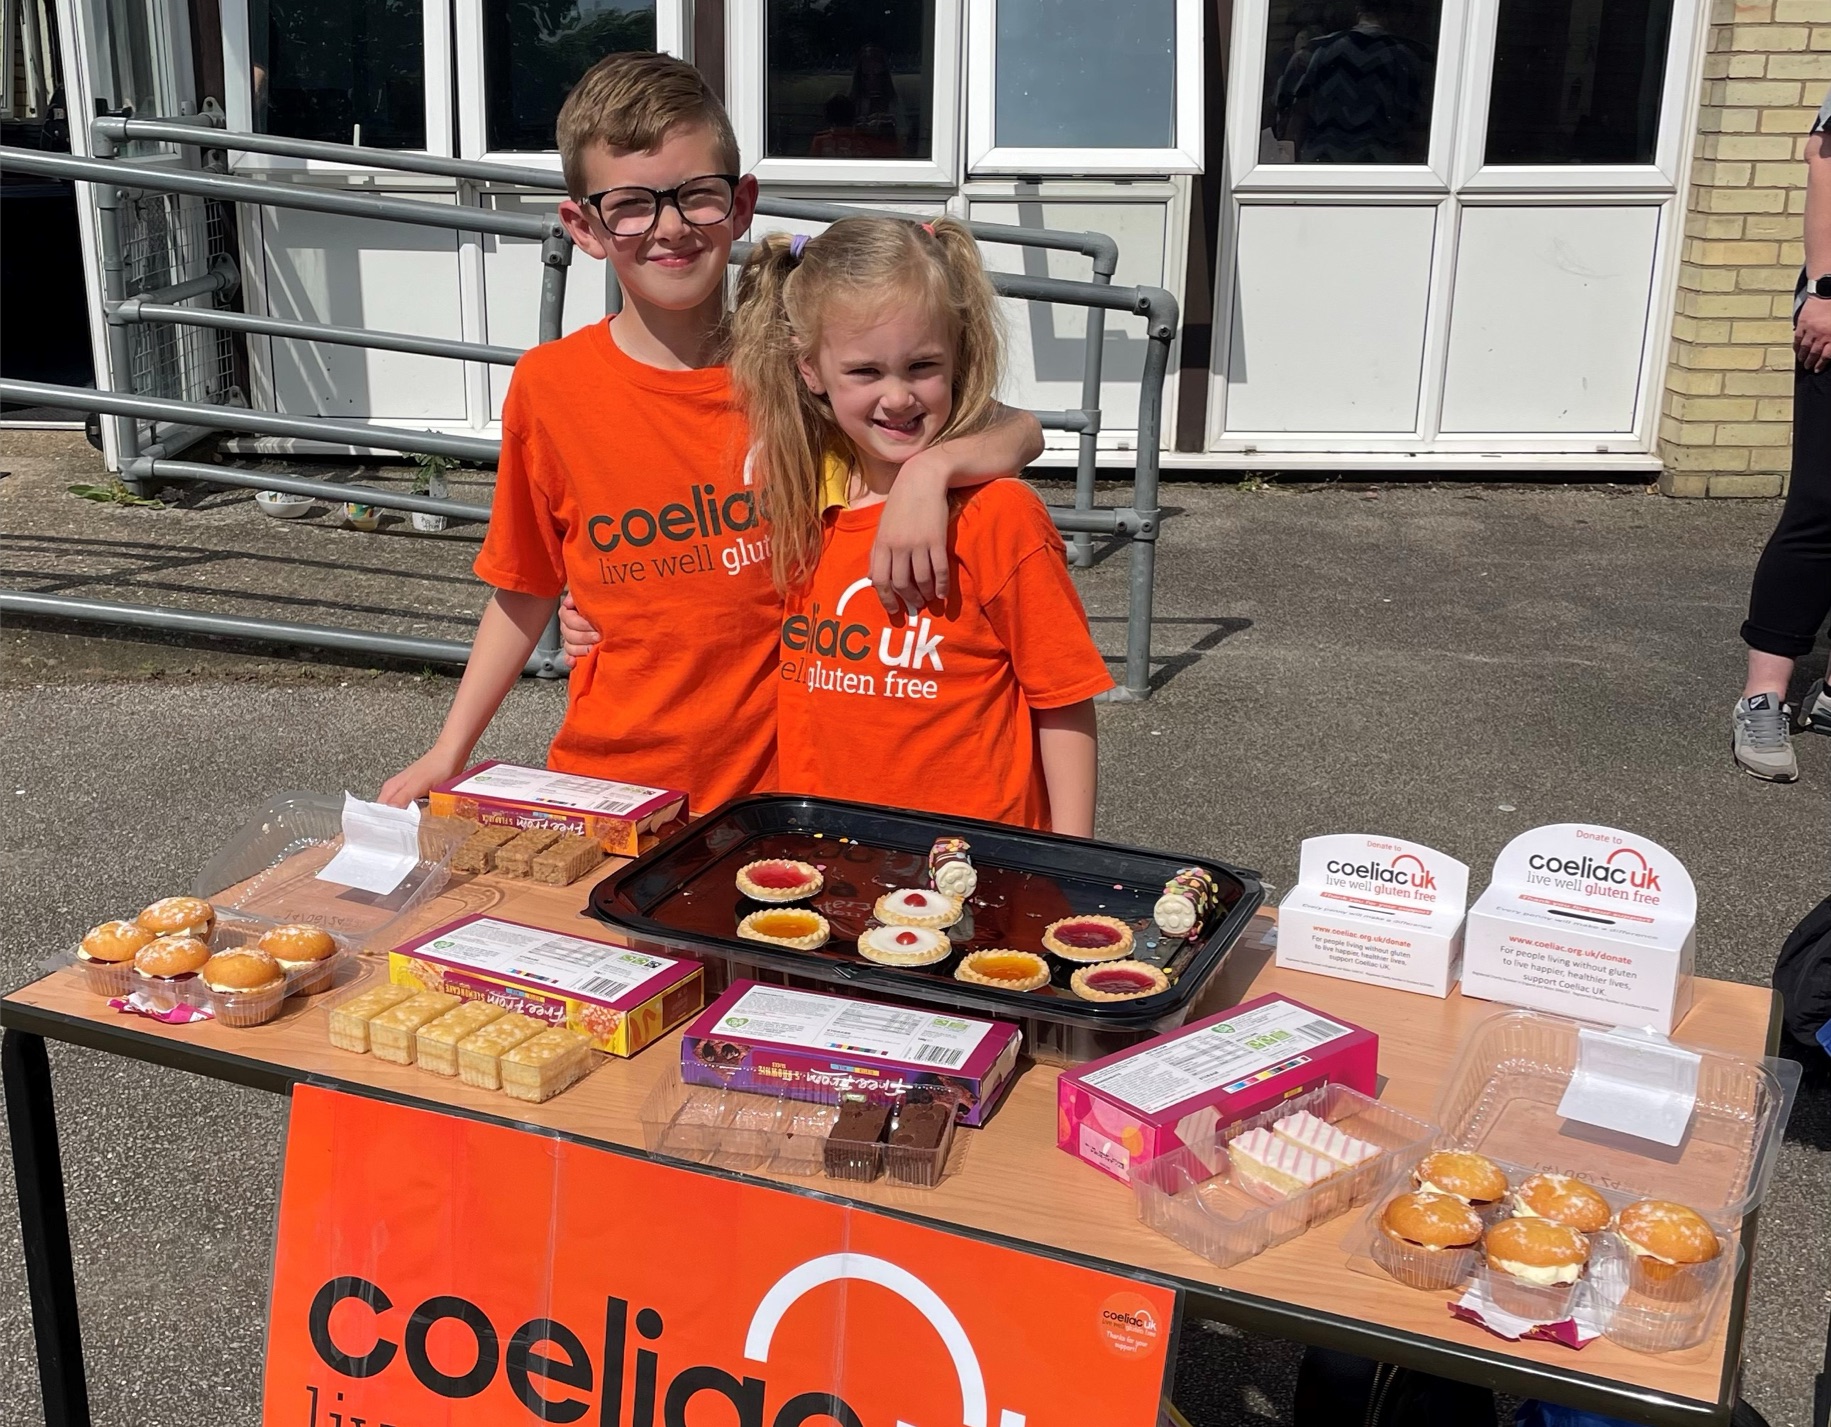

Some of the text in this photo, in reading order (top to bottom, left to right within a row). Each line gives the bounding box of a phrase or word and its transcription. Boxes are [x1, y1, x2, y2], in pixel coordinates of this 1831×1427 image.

[599, 534, 772, 585] live well glut
[878, 617, 945, 672] uk
[807, 660, 876, 693] gluten
[883, 670, 938, 699] free
[1366, 840, 1402, 852] Donate to
[1576, 829, 1623, 845] Donate to
[1327, 860, 1437, 891] coeliac uk
[1529, 854, 1661, 892] coeliac uk
[1325, 874, 1436, 903] live well gluten free
[1526, 871, 1660, 906] live well gluten free
[1312, 925, 1412, 948] www.coeliac.org.uk/donate
[1323, 937, 1345, 947] people
[1346, 940, 1364, 951] living
[1365, 943, 1389, 955] without
[1390, 947, 1411, 959] gluten
[1509, 935, 1632, 965] www.coeliac.org.uk/donate
[1323, 944, 1333, 952] live
[1361, 950, 1389, 962] healthier
[1329, 954, 1353, 964] support
[1355, 957, 1378, 968] Coeliac
[1500, 945, 1637, 980] For people living without gluten
[1503, 957, 1632, 991] to live happier, healthier lives,
[1523, 974, 1556, 988] support
[1559, 980, 1590, 994] Coeliac
[526, 1003, 568, 1022] Free
[1103, 1310, 1157, 1332] coeliac uk
